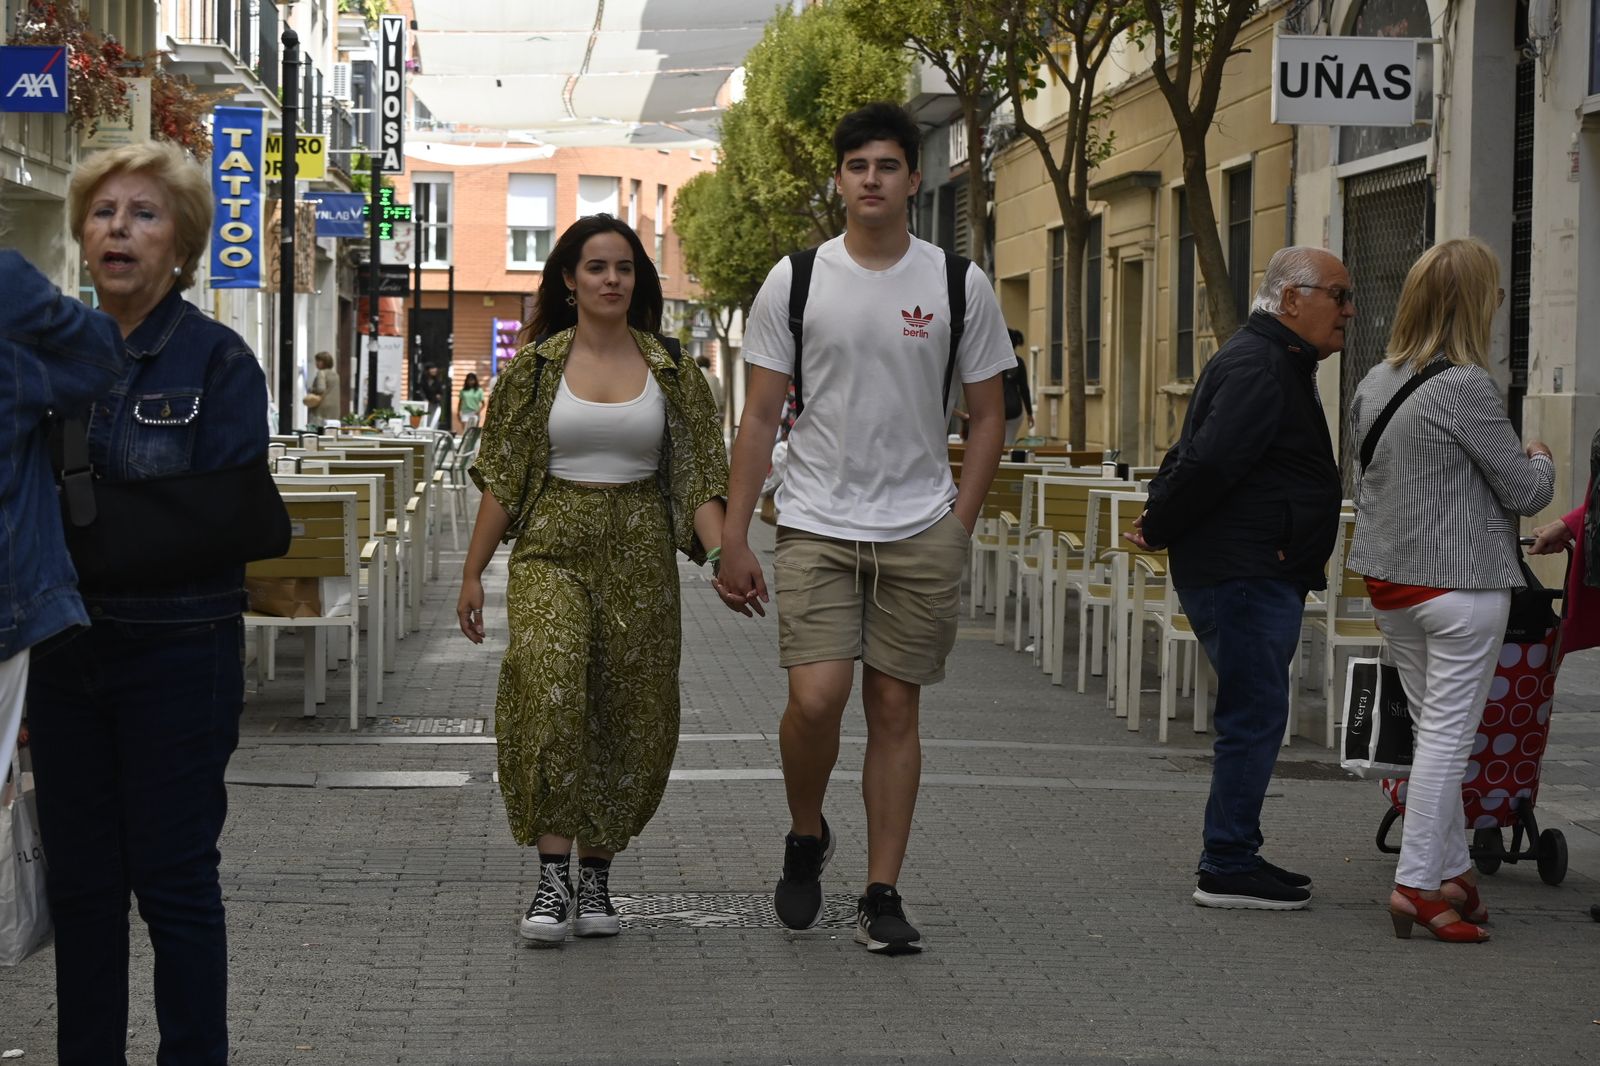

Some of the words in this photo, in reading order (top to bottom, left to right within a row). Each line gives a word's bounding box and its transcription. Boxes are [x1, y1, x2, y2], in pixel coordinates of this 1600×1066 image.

[6, 73, 59, 98] AXA
[1280, 54, 1412, 101] UÑAS
[383, 19, 401, 170] VIDOSA
[265, 137, 322, 154] MRO
[219, 128, 254, 268] TATTOO
[314, 210, 350, 221] YNLAB
[903, 327, 929, 339] berlin
[17, 846, 43, 865] FLO
